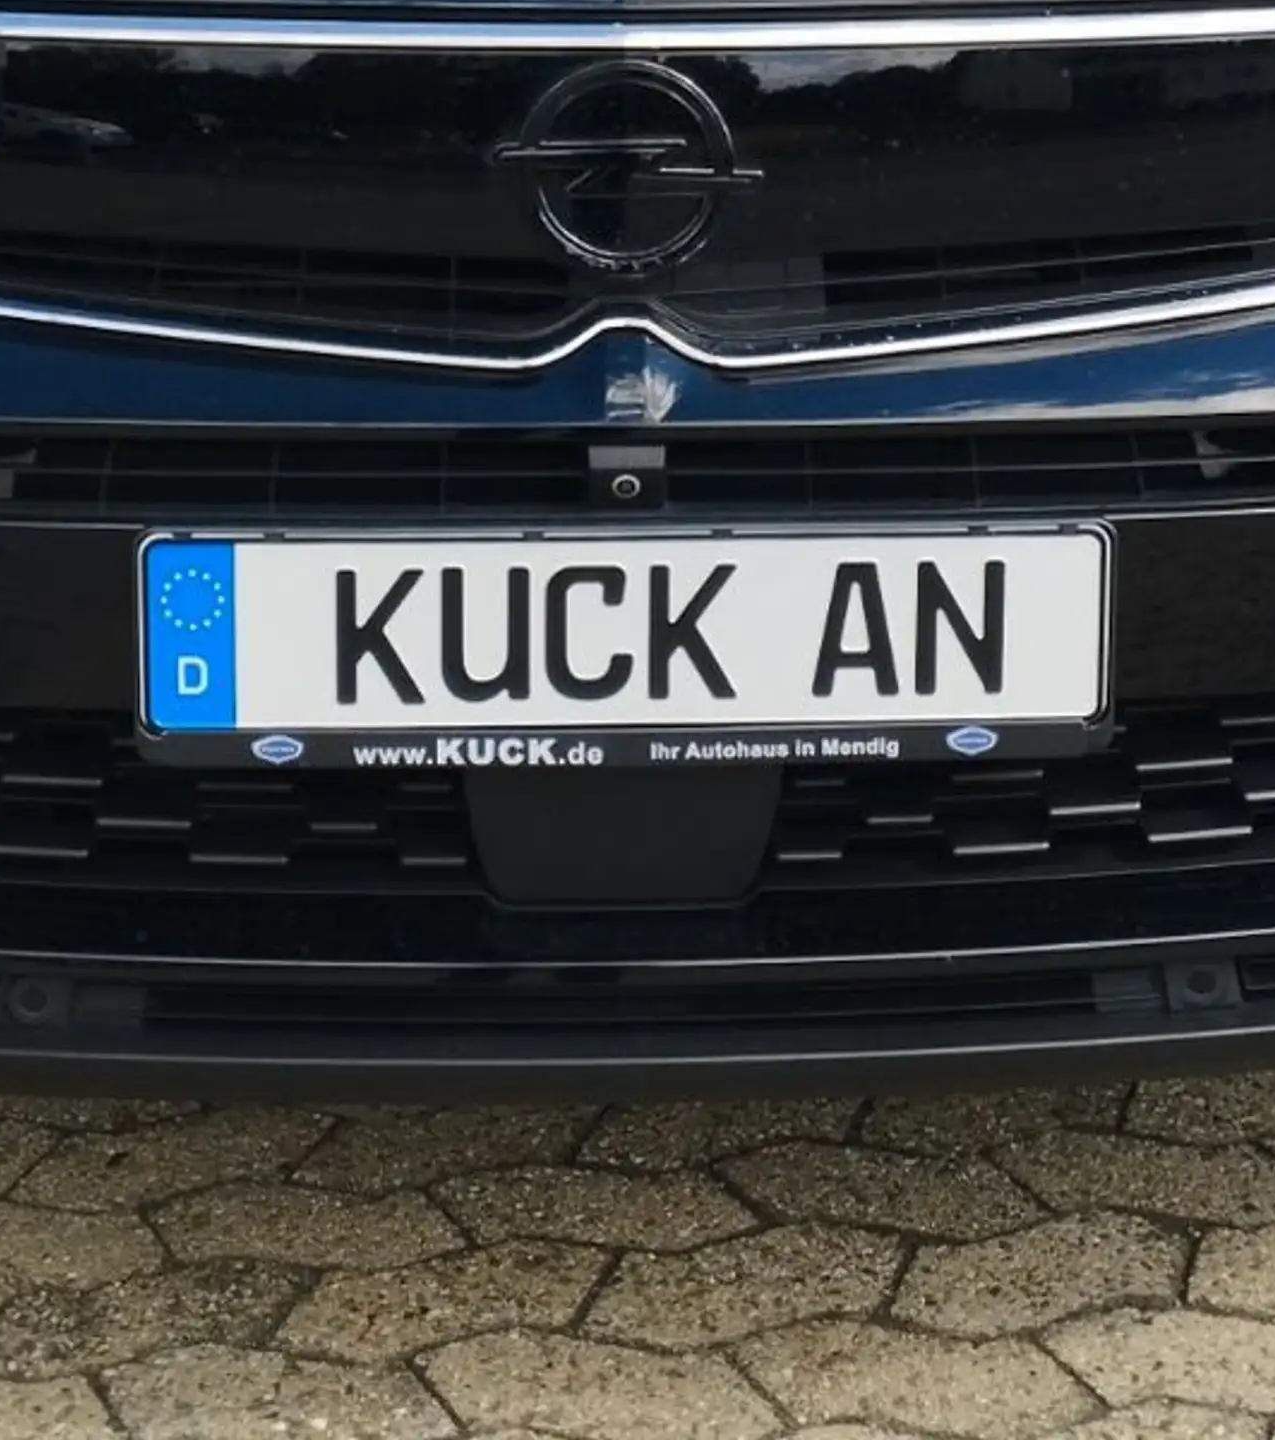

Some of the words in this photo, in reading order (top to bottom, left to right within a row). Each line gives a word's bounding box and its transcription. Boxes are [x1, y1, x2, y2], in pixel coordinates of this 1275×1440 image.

[336, 565, 737, 705] KUCK
[812, 560, 1005, 697] AN
[177, 655, 209, 695] D
[352, 737, 604, 766] www.KUCK.de
[650, 742, 680, 760] Ihr
[686, 740, 789, 760] Autohaus
[795, 738, 815, 756] in
[821, 736, 900, 758] Mendig
